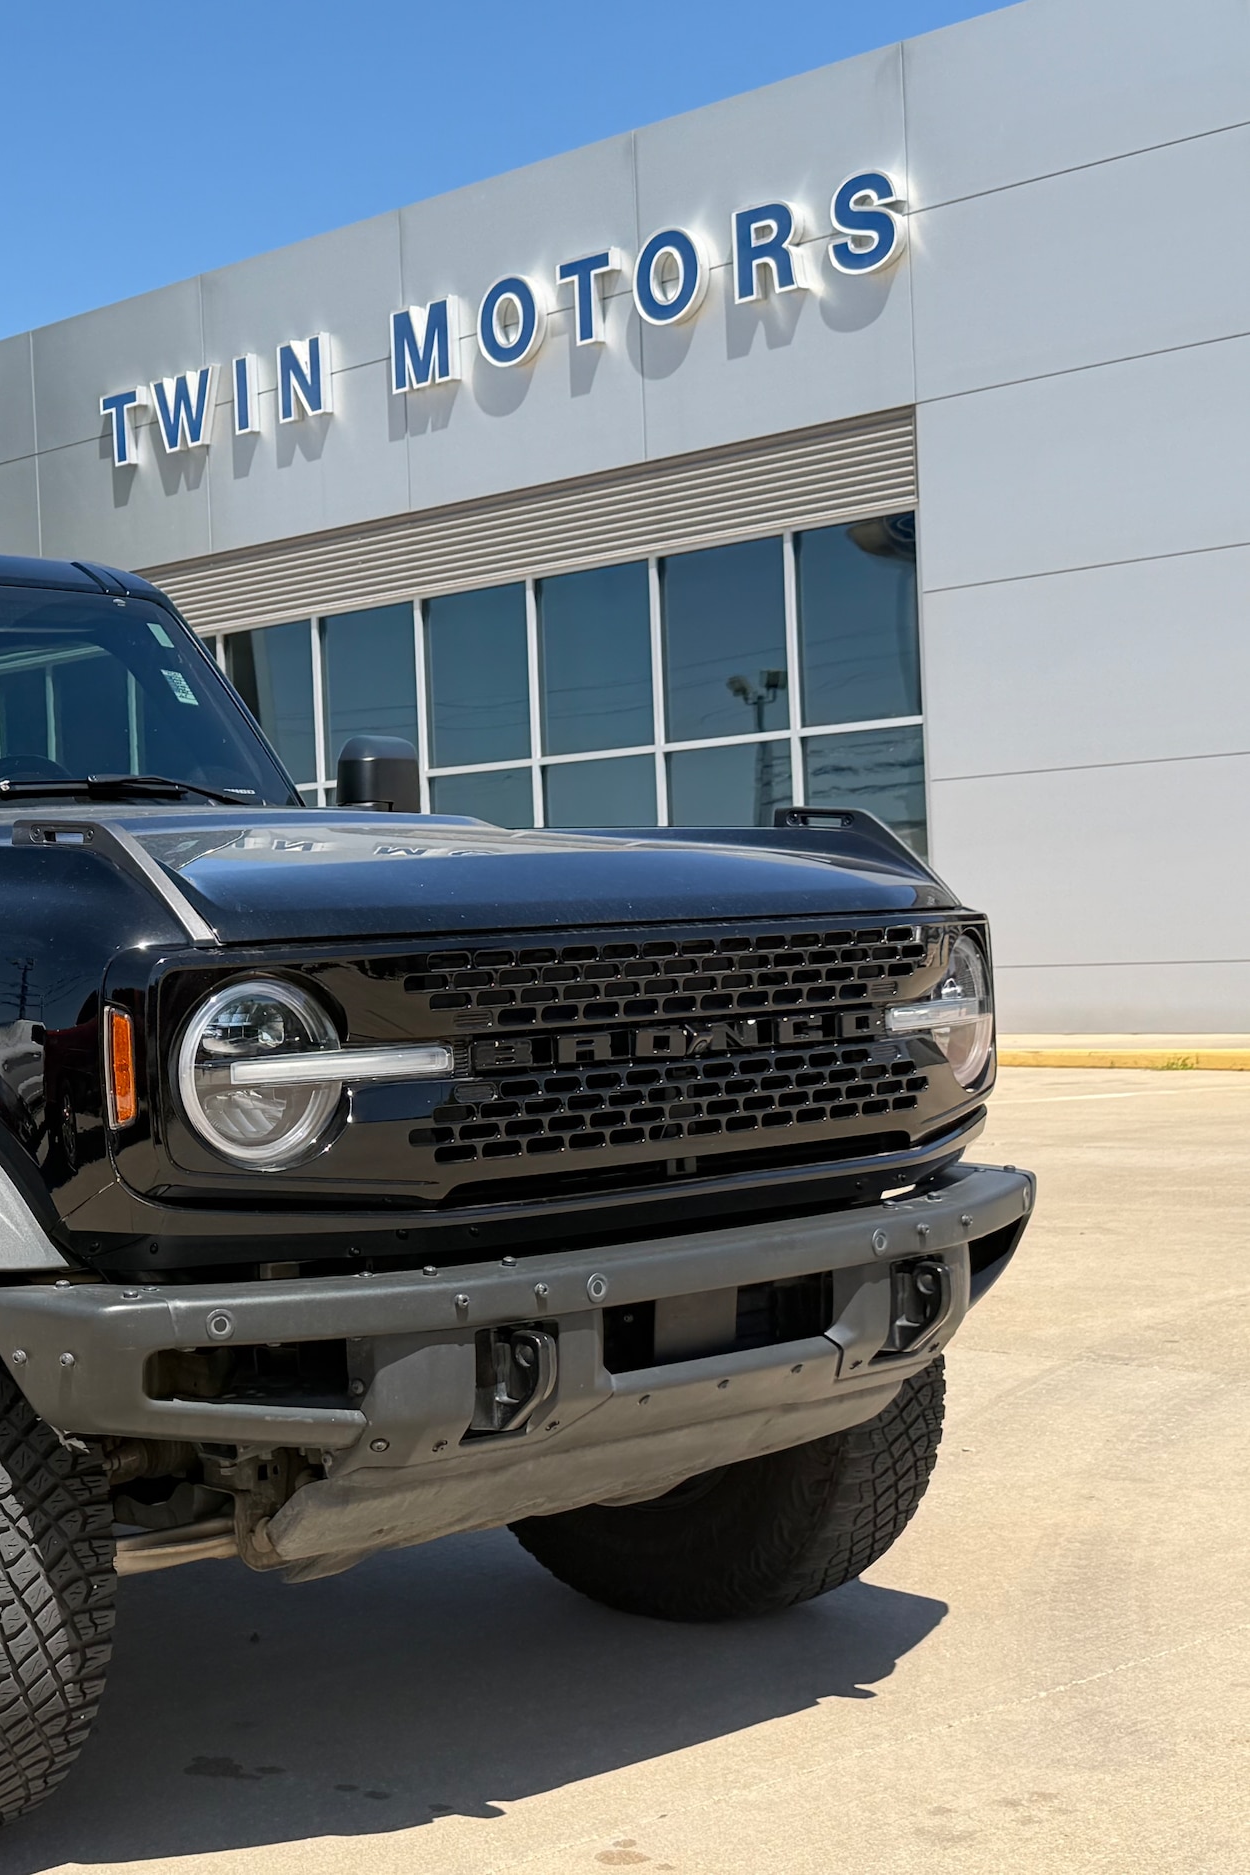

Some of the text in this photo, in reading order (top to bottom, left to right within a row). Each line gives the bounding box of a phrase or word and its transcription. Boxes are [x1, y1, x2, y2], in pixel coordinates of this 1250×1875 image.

[98, 168, 908, 467] TWIN MOTORS
[470, 1013, 884, 1068] BRONCO
